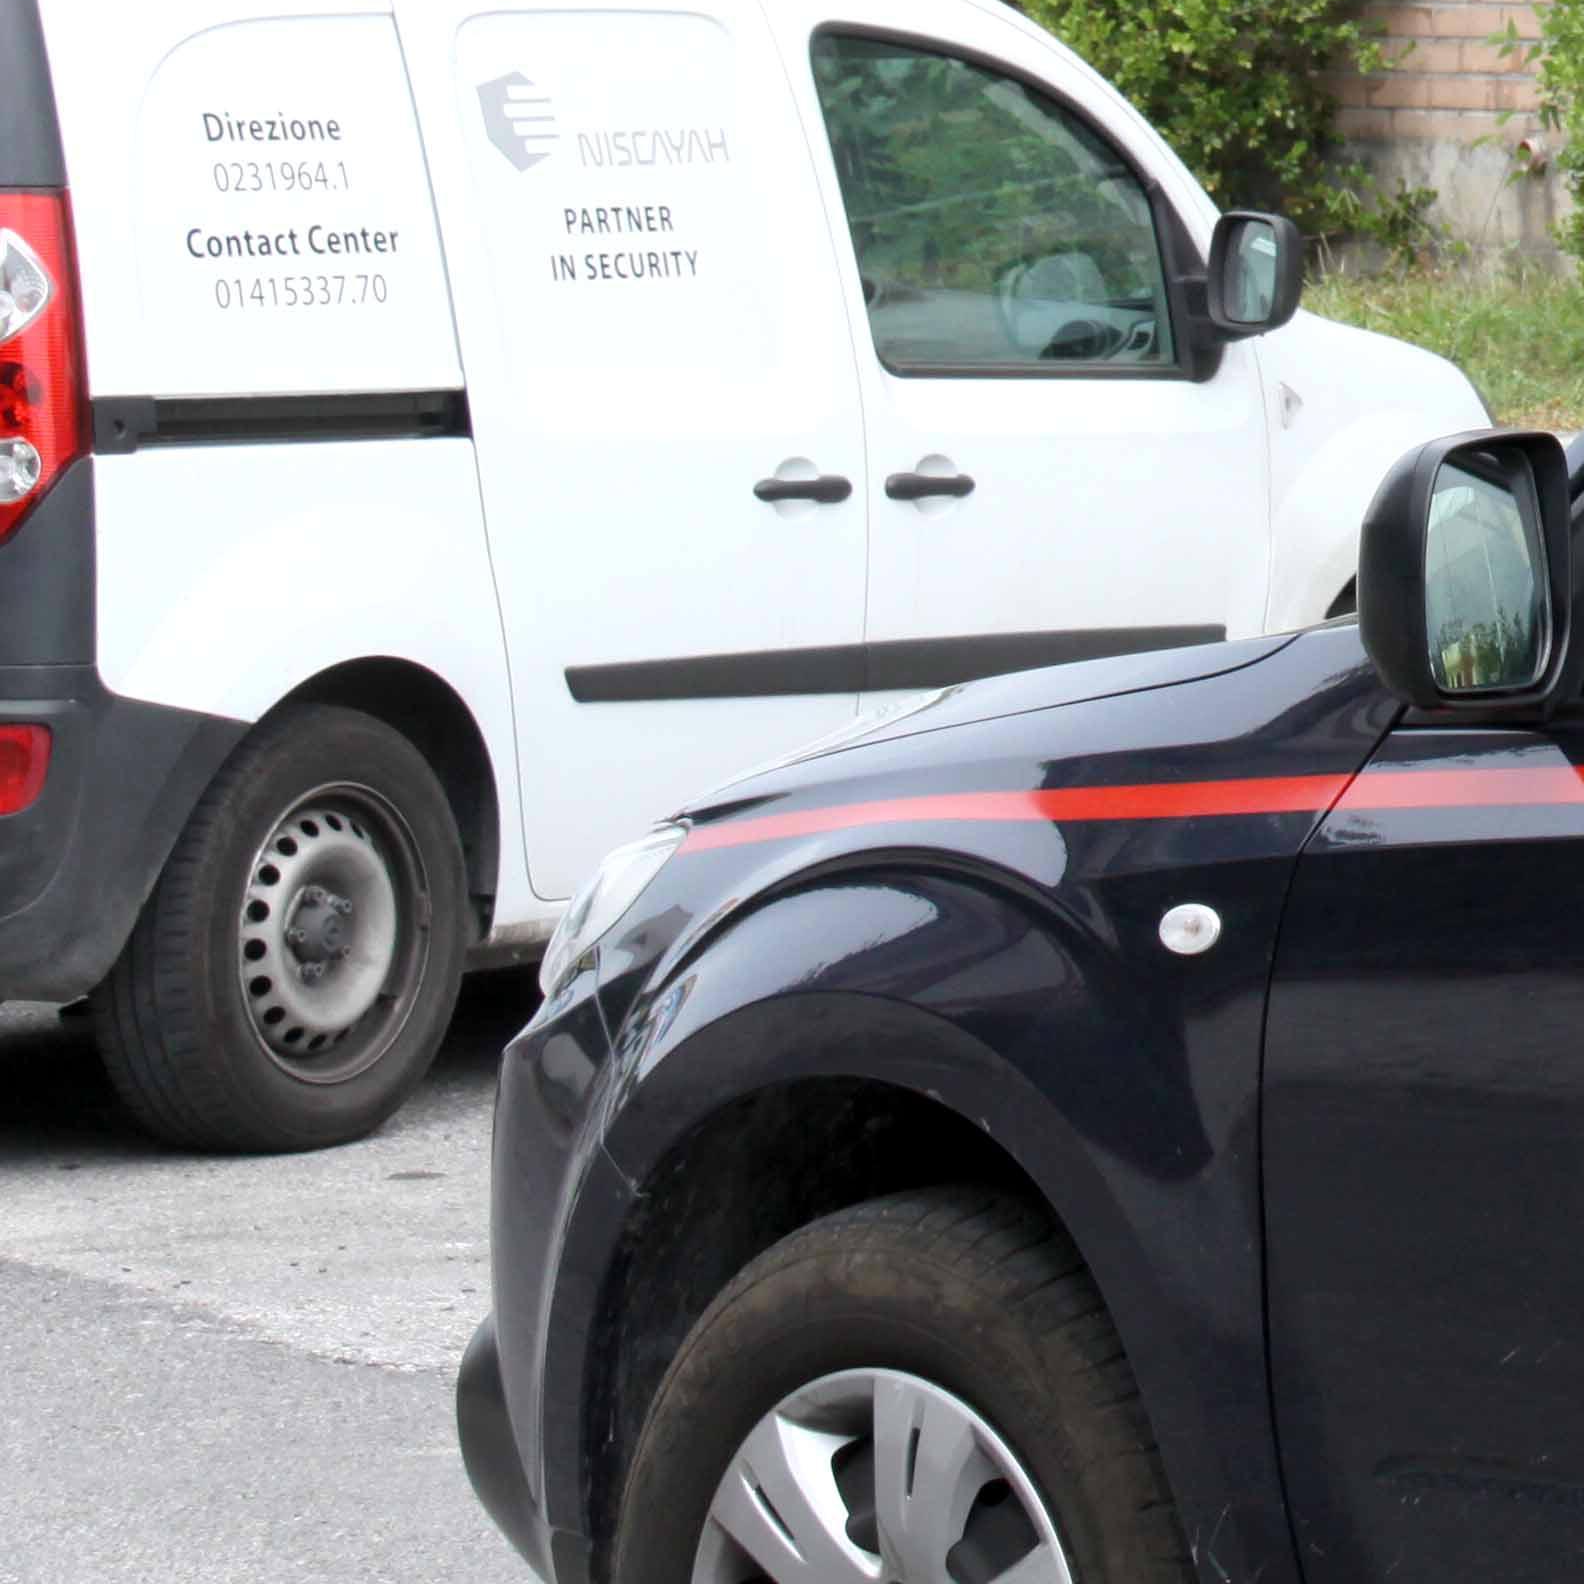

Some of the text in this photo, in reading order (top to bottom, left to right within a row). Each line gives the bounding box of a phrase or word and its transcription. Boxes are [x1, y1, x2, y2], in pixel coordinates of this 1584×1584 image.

[202, 111, 342, 142] Direzione
[576, 127, 731, 167] NISCAYAH
[213, 160, 350, 192] 0231964.1
[563, 205, 674, 234] PARTNER
[186, 224, 400, 259] Contact Center
[550, 249, 698, 281] IN SECURITY
[214, 273, 388, 309] 01415337.70
